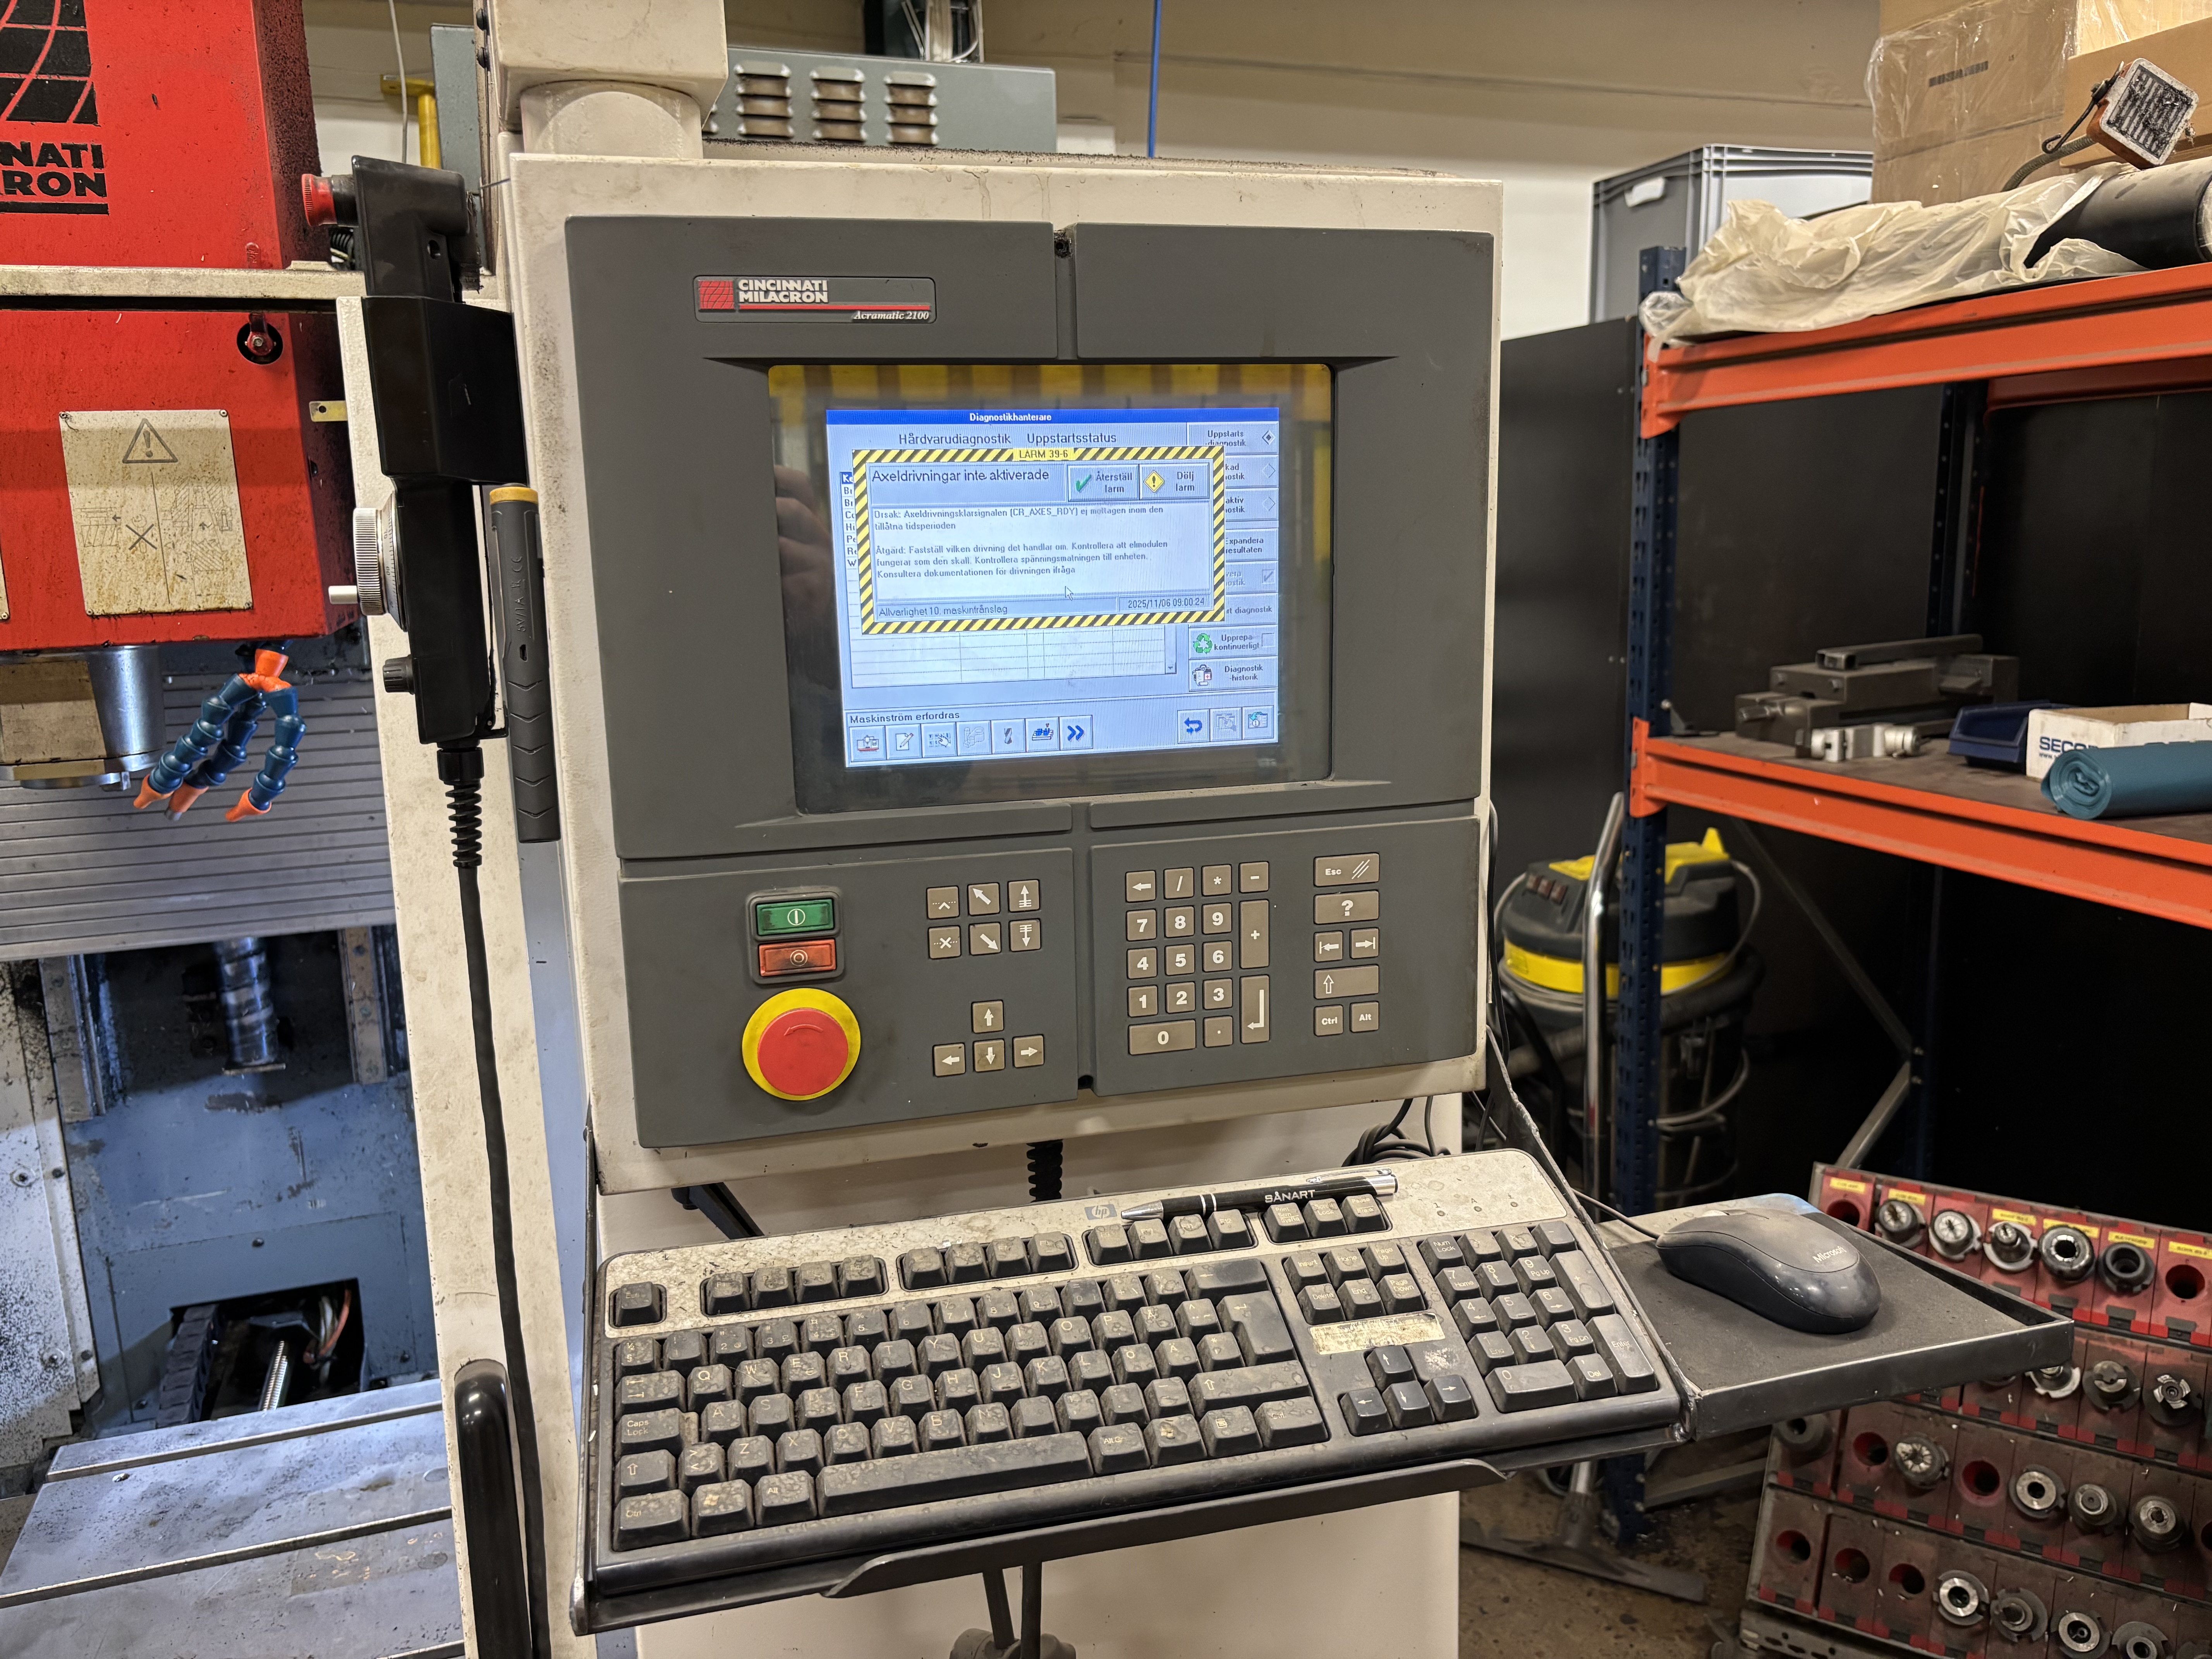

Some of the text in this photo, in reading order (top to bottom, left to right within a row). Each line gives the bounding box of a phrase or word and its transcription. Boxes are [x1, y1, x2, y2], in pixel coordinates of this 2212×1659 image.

[738, 279, 828, 291] CINCINNATI
[738, 291, 828, 303] MILACRON
[854, 311, 929, 320] Acramatic 2100
[969, 413, 1052, 422] Diagnostikhanterare
[1207, 430, 1244, 439] Uppstarts
[899, 433, 1116, 447] Hårdvarudiagnostik Uppstartsstatus
[1019, 449, 1068, 459] LARM 39-6
[872, 469, 1049, 484] Axeldrivningar inte aktiverade
[1096, 470, 1132, 481] Återställ
[1177, 471, 1194, 481] Dölj
[874, 510, 901, 519] Orsak:
[903, 509, 1007, 519] Axeldrivningsklarsignalen
[1010, 507, 1078, 517] (CR_AXES_RDY)
[1080, 507, 1087, 516] ej
[1090, 507, 1126, 515] mottagen
[875, 522, 956, 531] tillåtna tidsperioden
[876, 545, 906, 556] Åtgärd:
[908, 545, 943, 554] Fastställ
[973, 544, 1005, 554] drivning
[1023, 543, 1052, 551] handlar
[1072, 542, 1114, 550] Kontrollera
[877, 558, 911, 567] fungerar
[933, 557, 948, 565] den
[975, 556, 1018, 564] Kontrollera
[1020, 555, 1100, 564] spänningsmatningen
[878, 570, 921, 578] Konsultera
[924, 568, 993, 577] dokumentationen
[1010, 567, 1051, 575] drivningen
[1053, 565, 1075, 574] ifråga
[879, 608, 927, 618] Allvarlighet
[944, 605, 1008, 616] maskinfrånslag
[1128, 598, 1170, 610] 2025/11/06
[1173, 597, 1204, 607] 09:00:24
[1235, 606, 1273, 615] diagnostik
[1221, 634, 1253, 643] Upprepa
[1214, 642, 1259, 651] kontinuerligt
[1224, 664, 1263, 673] Diagnostik
[850, 711, 960, 723] Maskinström erfordras
[1137, 912, 1224, 933] 7 8 9
[1137, 950, 1224, 970] 4 5 6
[1139, 988, 1224, 1008] 1 2 3
[1321, 1013, 1372, 1025] Ctrl Alt
[1158, 1031, 1169, 1044] 0
[1264, 1189, 1316, 1203] SÅNART
[1094, 1205, 1108, 1219] hp
[1812, 1245, 1847, 1263] Microsoft
[1298, 1259, 1318, 1267] Insert
[1524, 1259, 1534, 1268] 9
[1486, 1264, 1496, 1274] 8
[1312, 1292, 1334, 1300] Delete
[1542, 1291, 1553, 1300] 6
[1467, 1302, 1475, 1311] 4
[1503, 1297, 1514, 1306] 5
[1103, 1316, 1112, 1326] P
[1561, 1324, 1571, 1333] 3
[974, 1333, 984, 1343] U
[1522, 1330, 1533, 1339] 2
[929, 1338, 939, 1348] Y
[1169, 1343, 1178, 1353] Ä
[1611, 1340, 1630, 1349] Enter
[838, 1352, 849, 1362] R
[792, 1358, 802, 1368] E
[1037, 1361, 1048, 1372] K
[745, 1365, 757, 1374] W
[993, 1367, 1001, 1379] J
[1587, 1370, 1601, 1378] Del
[698, 1370, 711, 1381] Q
[946, 1374, 958, 1384] H
[902, 1380, 913, 1390] G
[760, 1399, 771, 1410] S
[712, 1407, 725, 1418] A
[627, 1419, 649, 1427] Caps
[884, 1422, 895, 1432] V
[627, 1427, 649, 1436] Lock
[788, 1436, 798, 1447] X
[739, 1443, 750, 1455] Z
